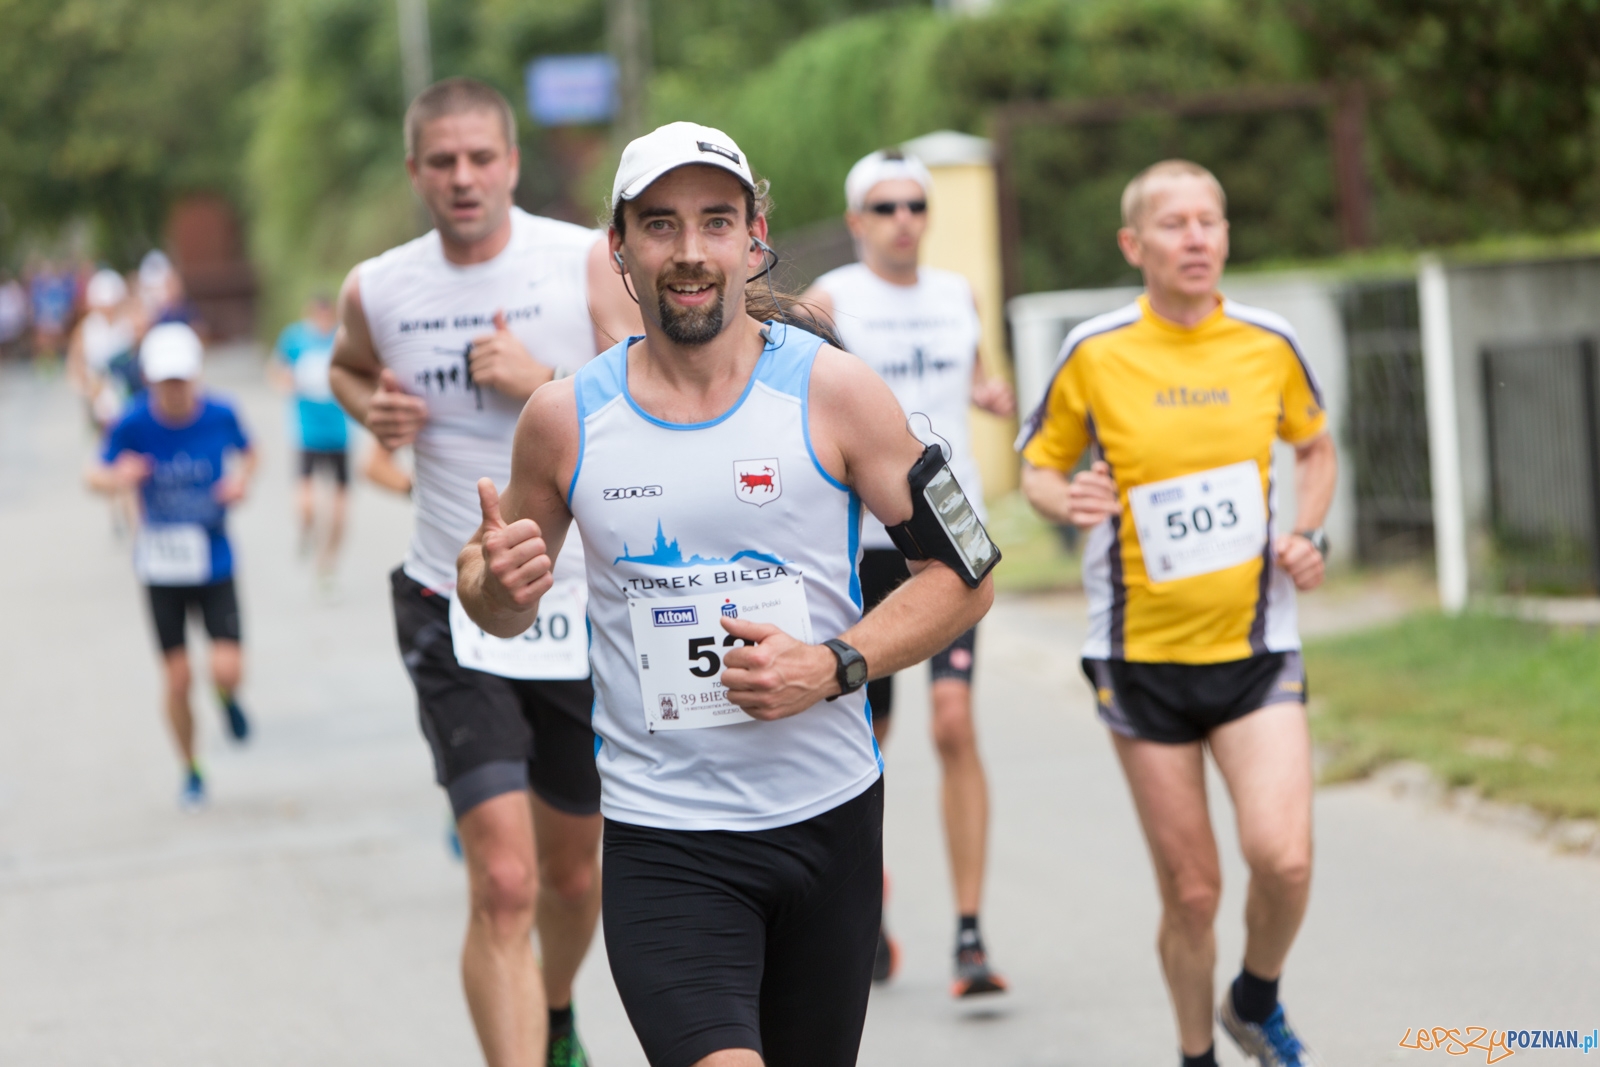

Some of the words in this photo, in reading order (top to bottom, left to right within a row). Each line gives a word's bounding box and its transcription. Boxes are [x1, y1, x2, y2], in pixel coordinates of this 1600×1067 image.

[1166, 499, 1239, 541] 503
[628, 573, 704, 592] TUREK
[714, 565, 788, 585] BIEGA
[681, 694, 696, 705] 39
